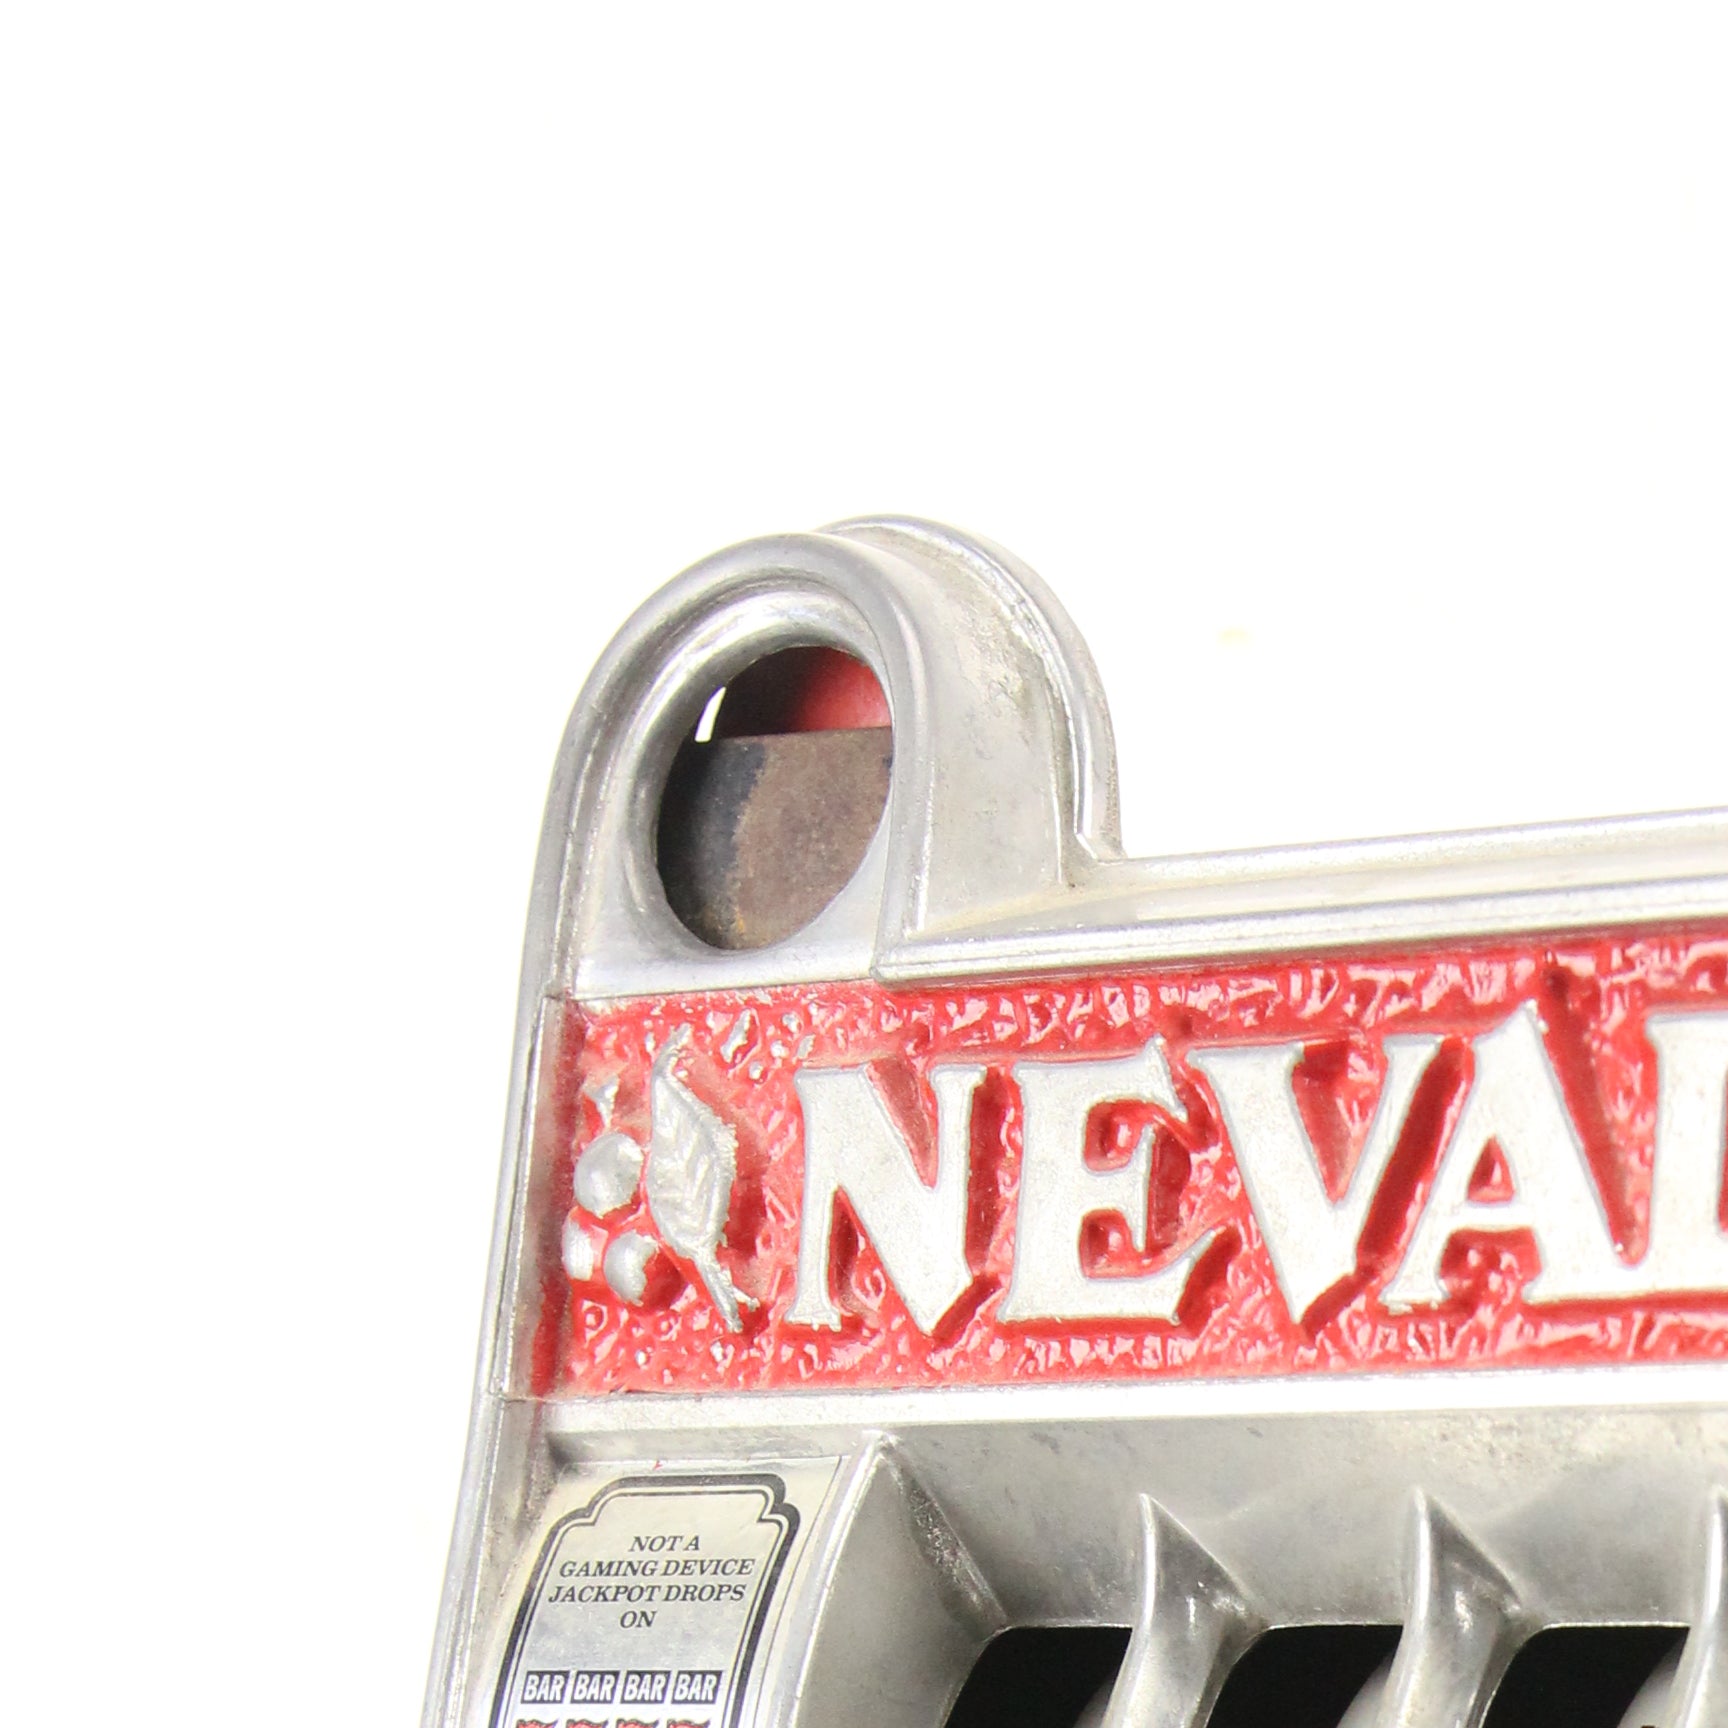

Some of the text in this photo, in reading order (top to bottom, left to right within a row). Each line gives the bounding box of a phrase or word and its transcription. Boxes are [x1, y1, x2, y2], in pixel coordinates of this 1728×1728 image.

[628, 1535, 701, 1552] NOT A
[559, 1558, 755, 1578] GAMING DEVICE
[549, 1584, 747, 1603] JACKPOT DROPS
[620, 1610, 657, 1628] ON
[524, 1674, 717, 1701] BAR BAR BAR BAR
